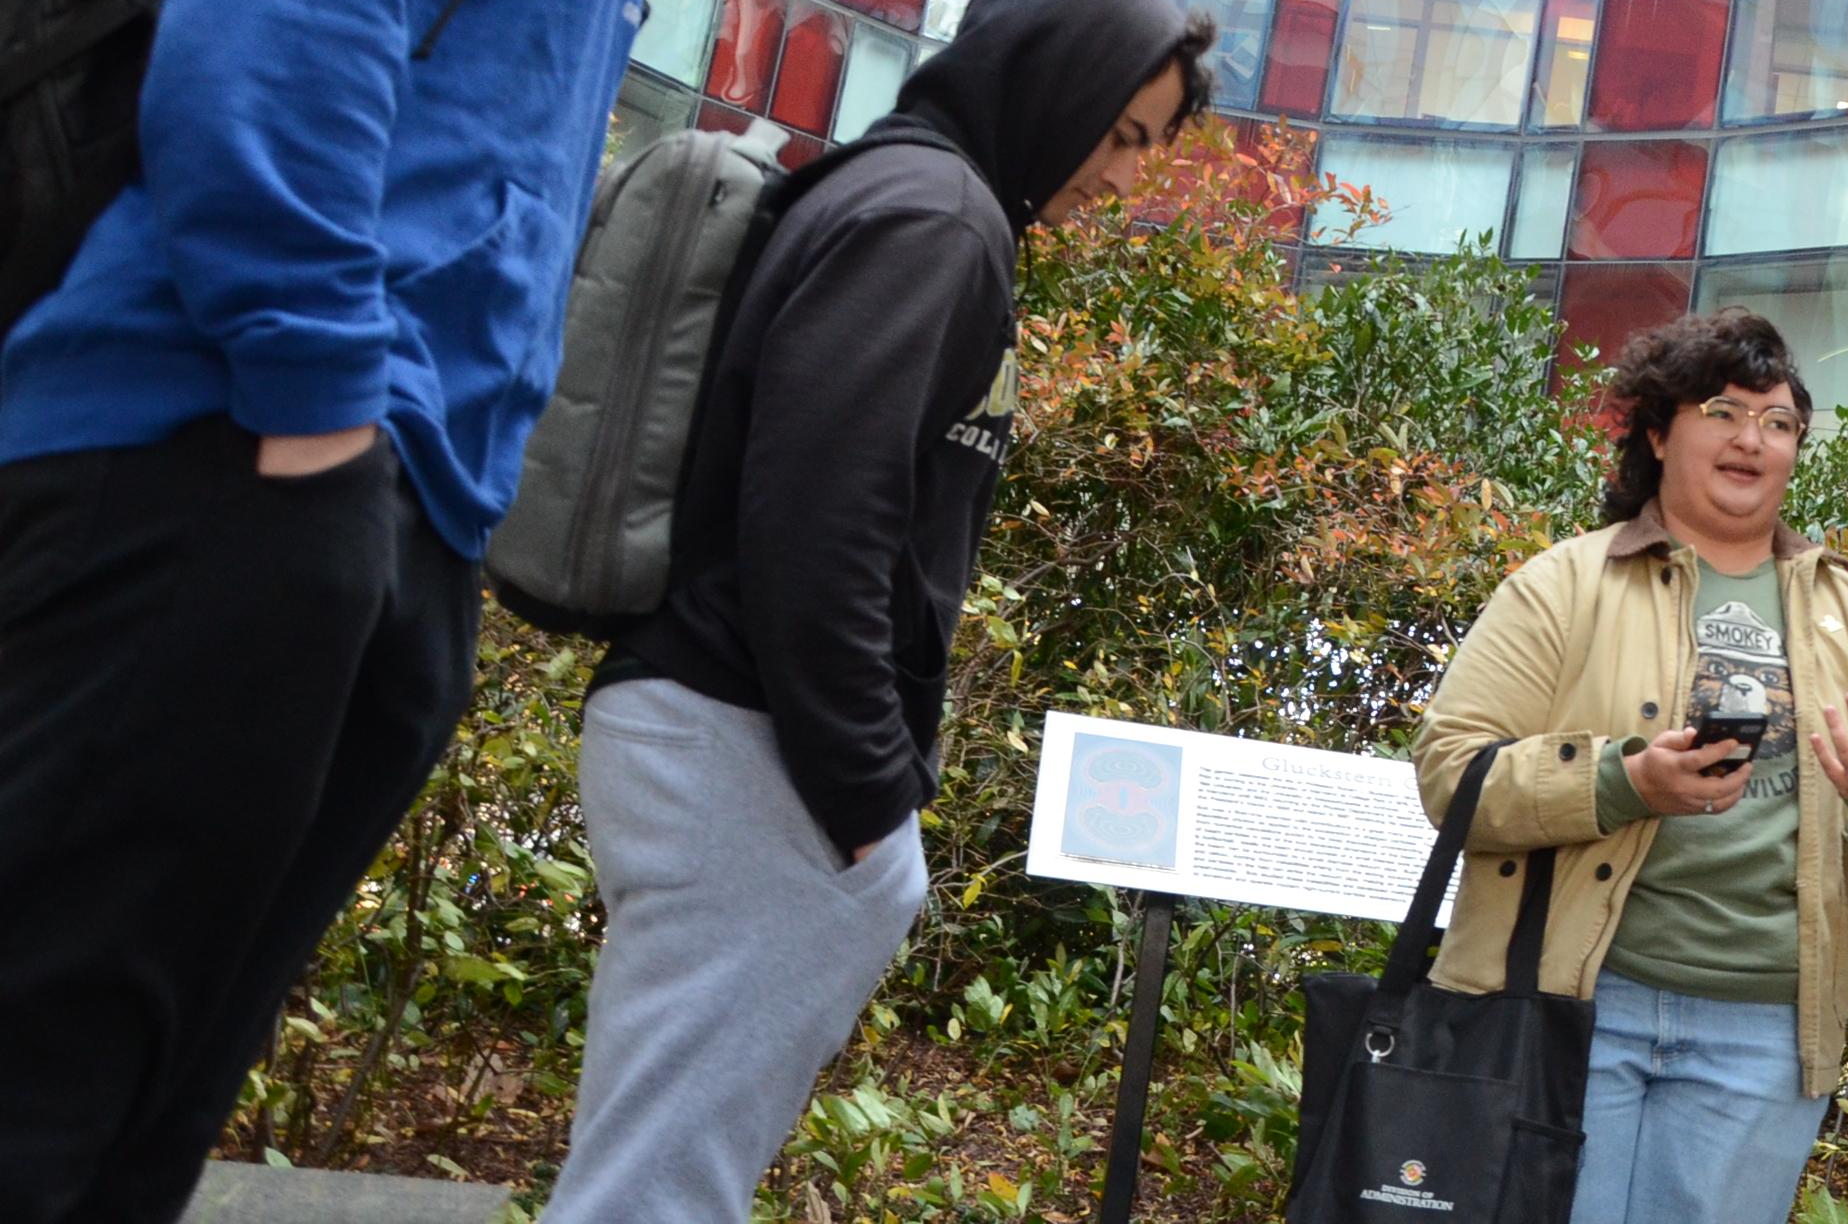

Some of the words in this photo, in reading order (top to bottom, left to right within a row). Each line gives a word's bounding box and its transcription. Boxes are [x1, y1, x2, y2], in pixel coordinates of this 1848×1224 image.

[1705, 623, 1773, 649] SMOKEY
[1262, 756, 1392, 787] Gluckstern
[1743, 765, 1798, 798] WILD
[1360, 1189, 1455, 1211] ADMINISTRATION
[1422, 1191, 1434, 1199] OF
